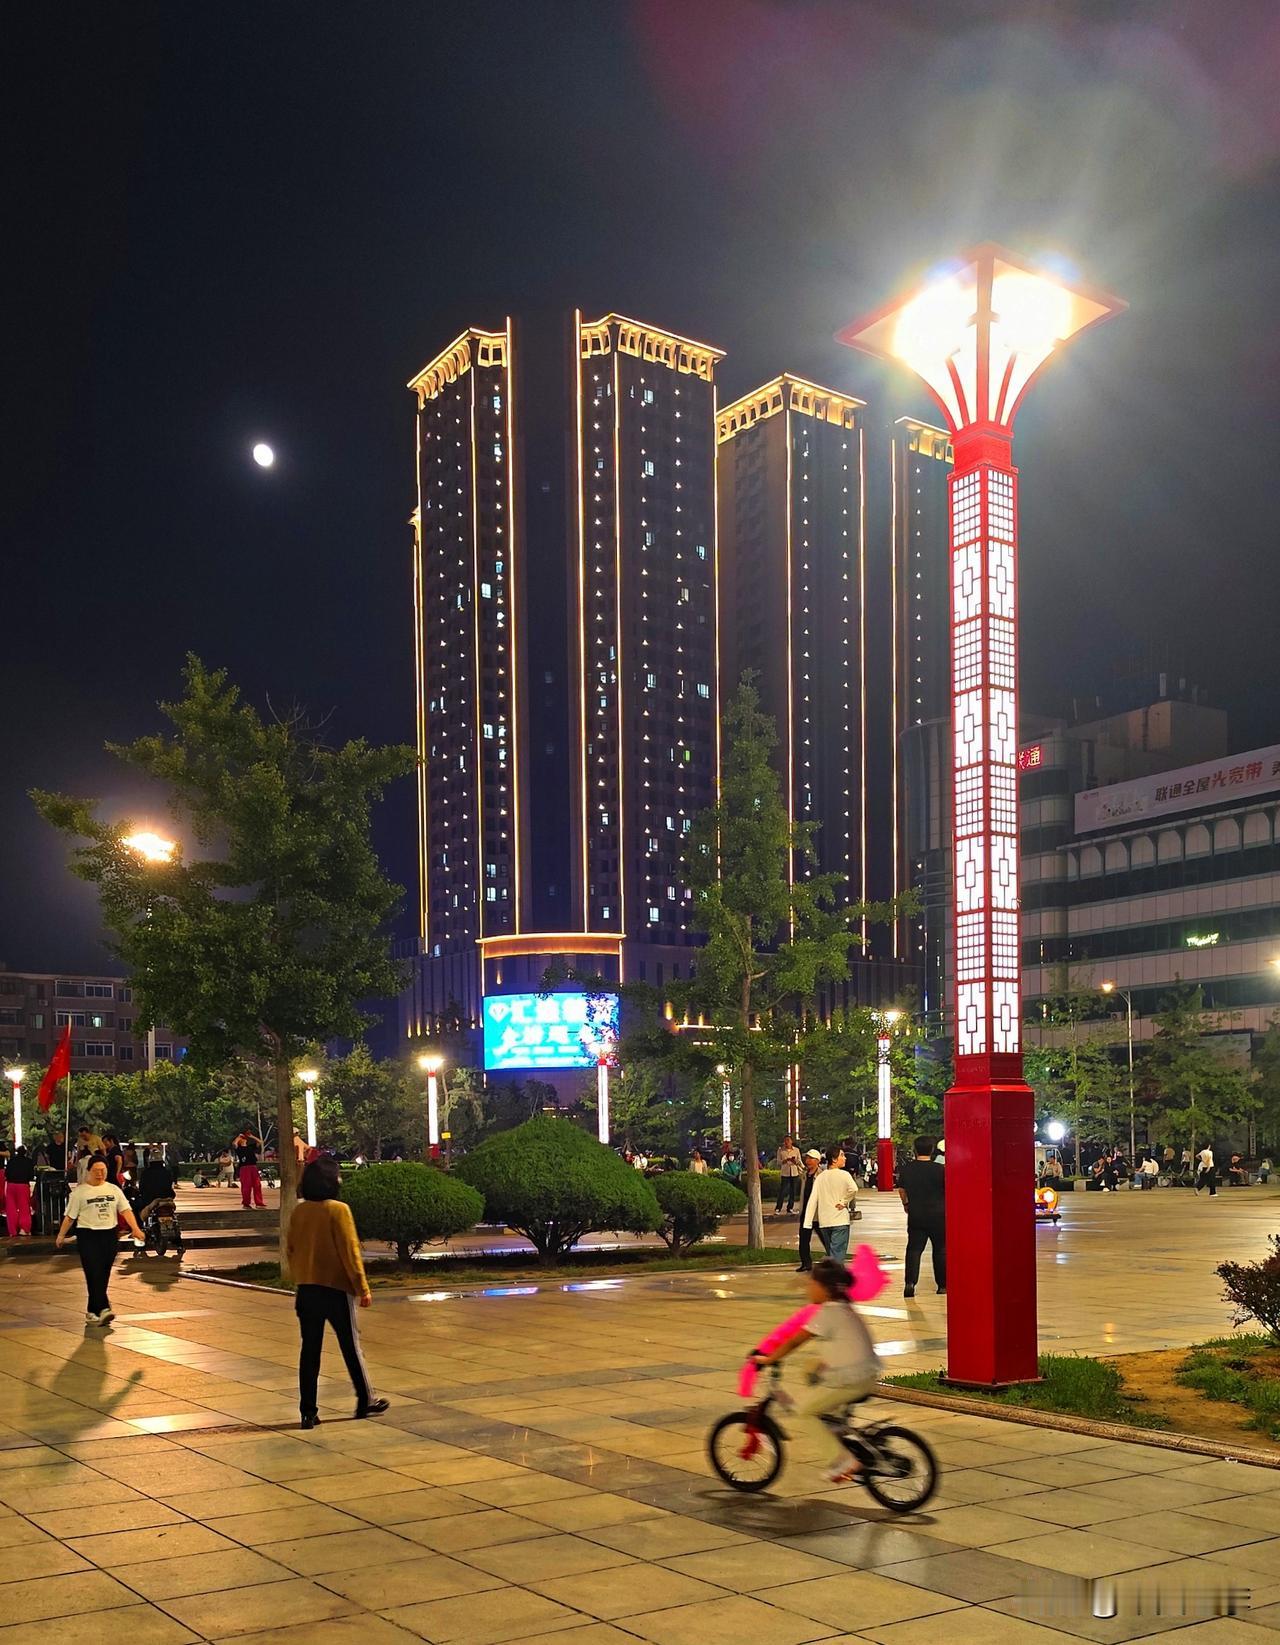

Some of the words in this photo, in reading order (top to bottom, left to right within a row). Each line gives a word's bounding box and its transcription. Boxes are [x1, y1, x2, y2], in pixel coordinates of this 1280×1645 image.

[1155, 761, 1263, 801] 联通全屋光宽带
